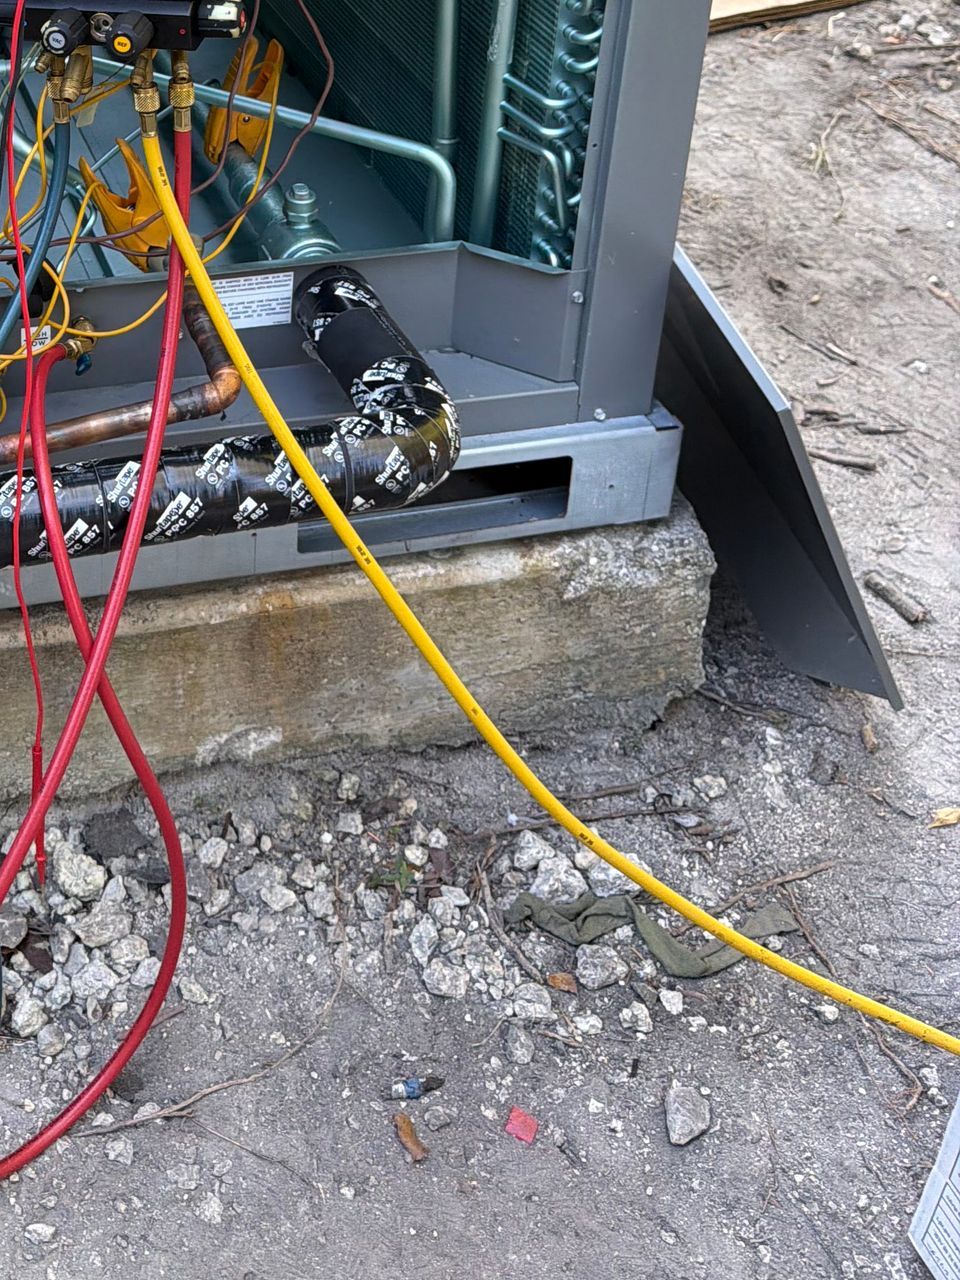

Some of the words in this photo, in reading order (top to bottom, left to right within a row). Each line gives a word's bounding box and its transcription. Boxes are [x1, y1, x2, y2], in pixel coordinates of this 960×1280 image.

[52, 37, 63, 45] VAC
[195, 446, 221, 480] Shurtape
[216, 460, 229, 475] PC
[107, 468, 133, 503] Shurtape
[185, 496, 203, 518] 857
[251, 502, 269, 521] 857
[82, 524, 100, 544] 857
